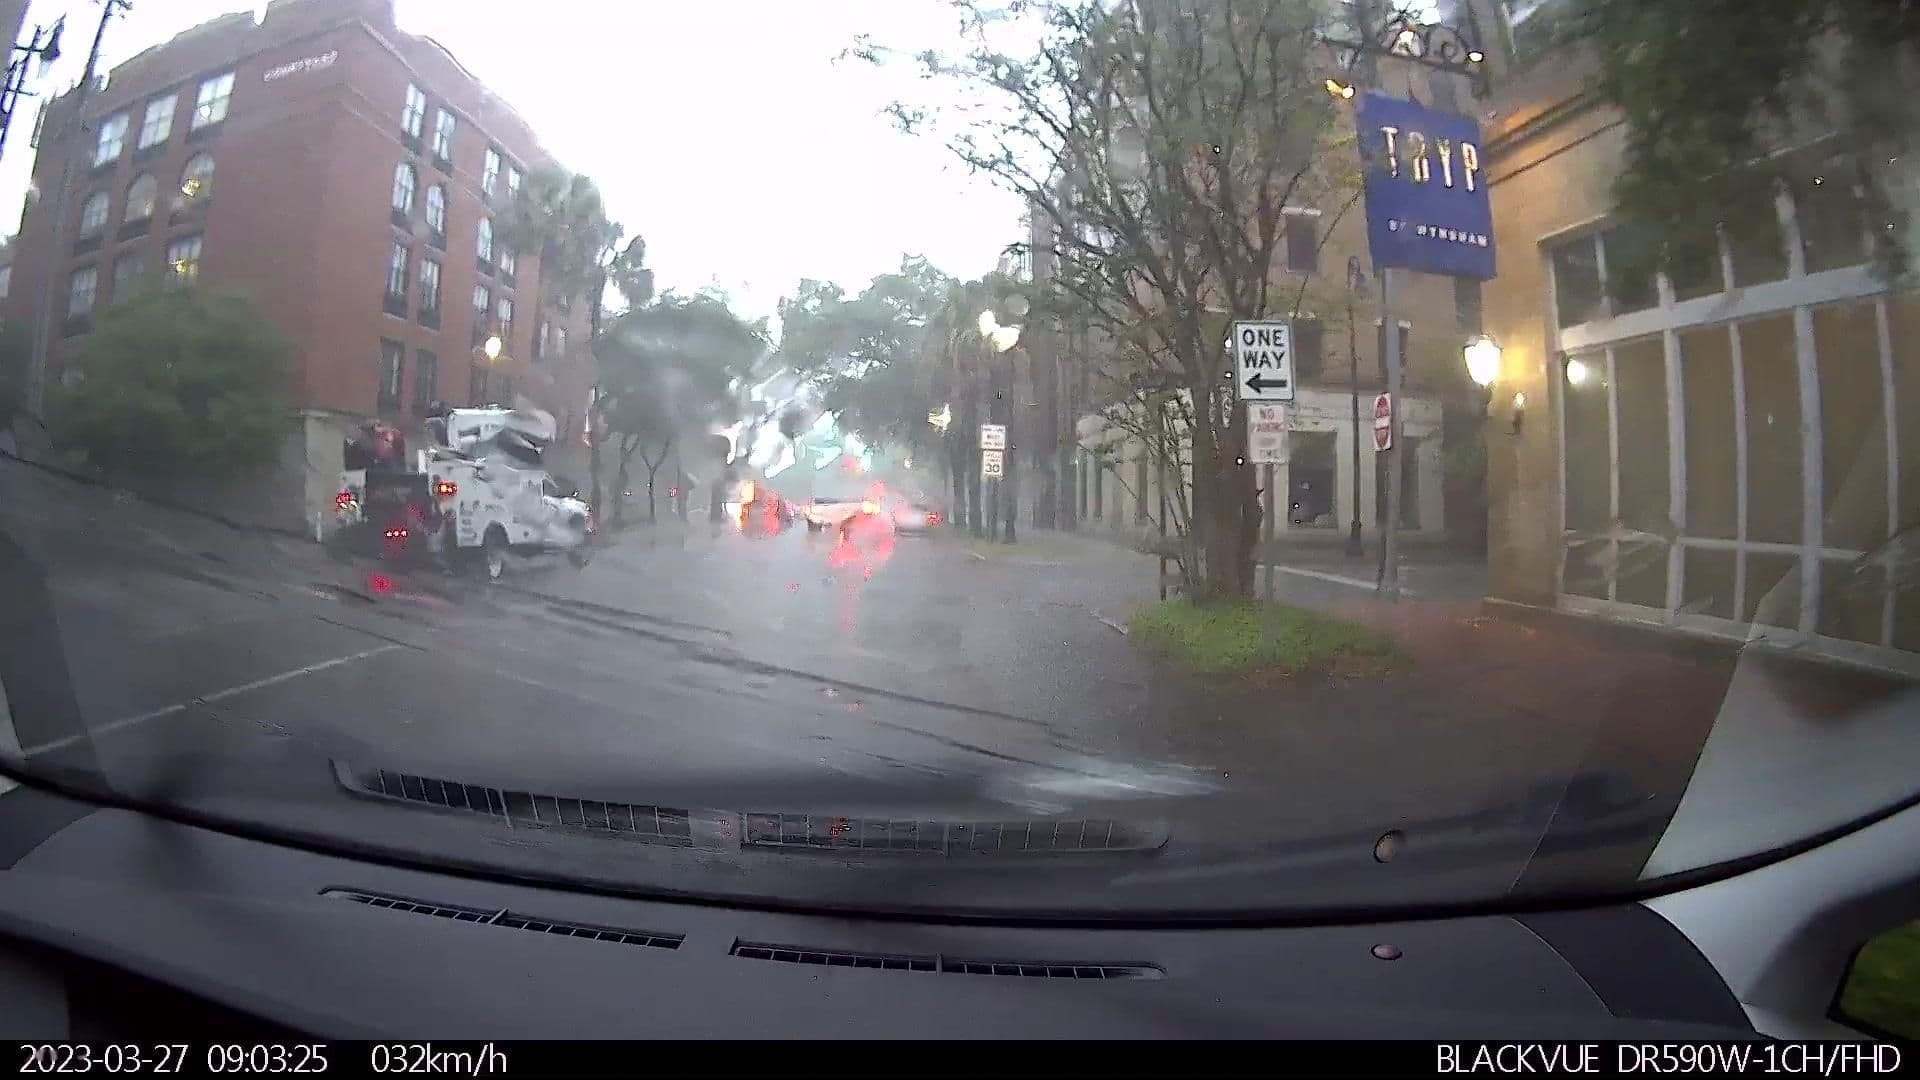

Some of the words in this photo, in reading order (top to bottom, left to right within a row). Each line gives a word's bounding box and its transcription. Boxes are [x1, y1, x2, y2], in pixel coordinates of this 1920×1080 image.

[1380, 126, 1479, 192] TRYP
[1243, 328, 1285, 347] ONE
[1243, 350, 1285, 369] WAY
[985, 464, 1000, 473] 30
